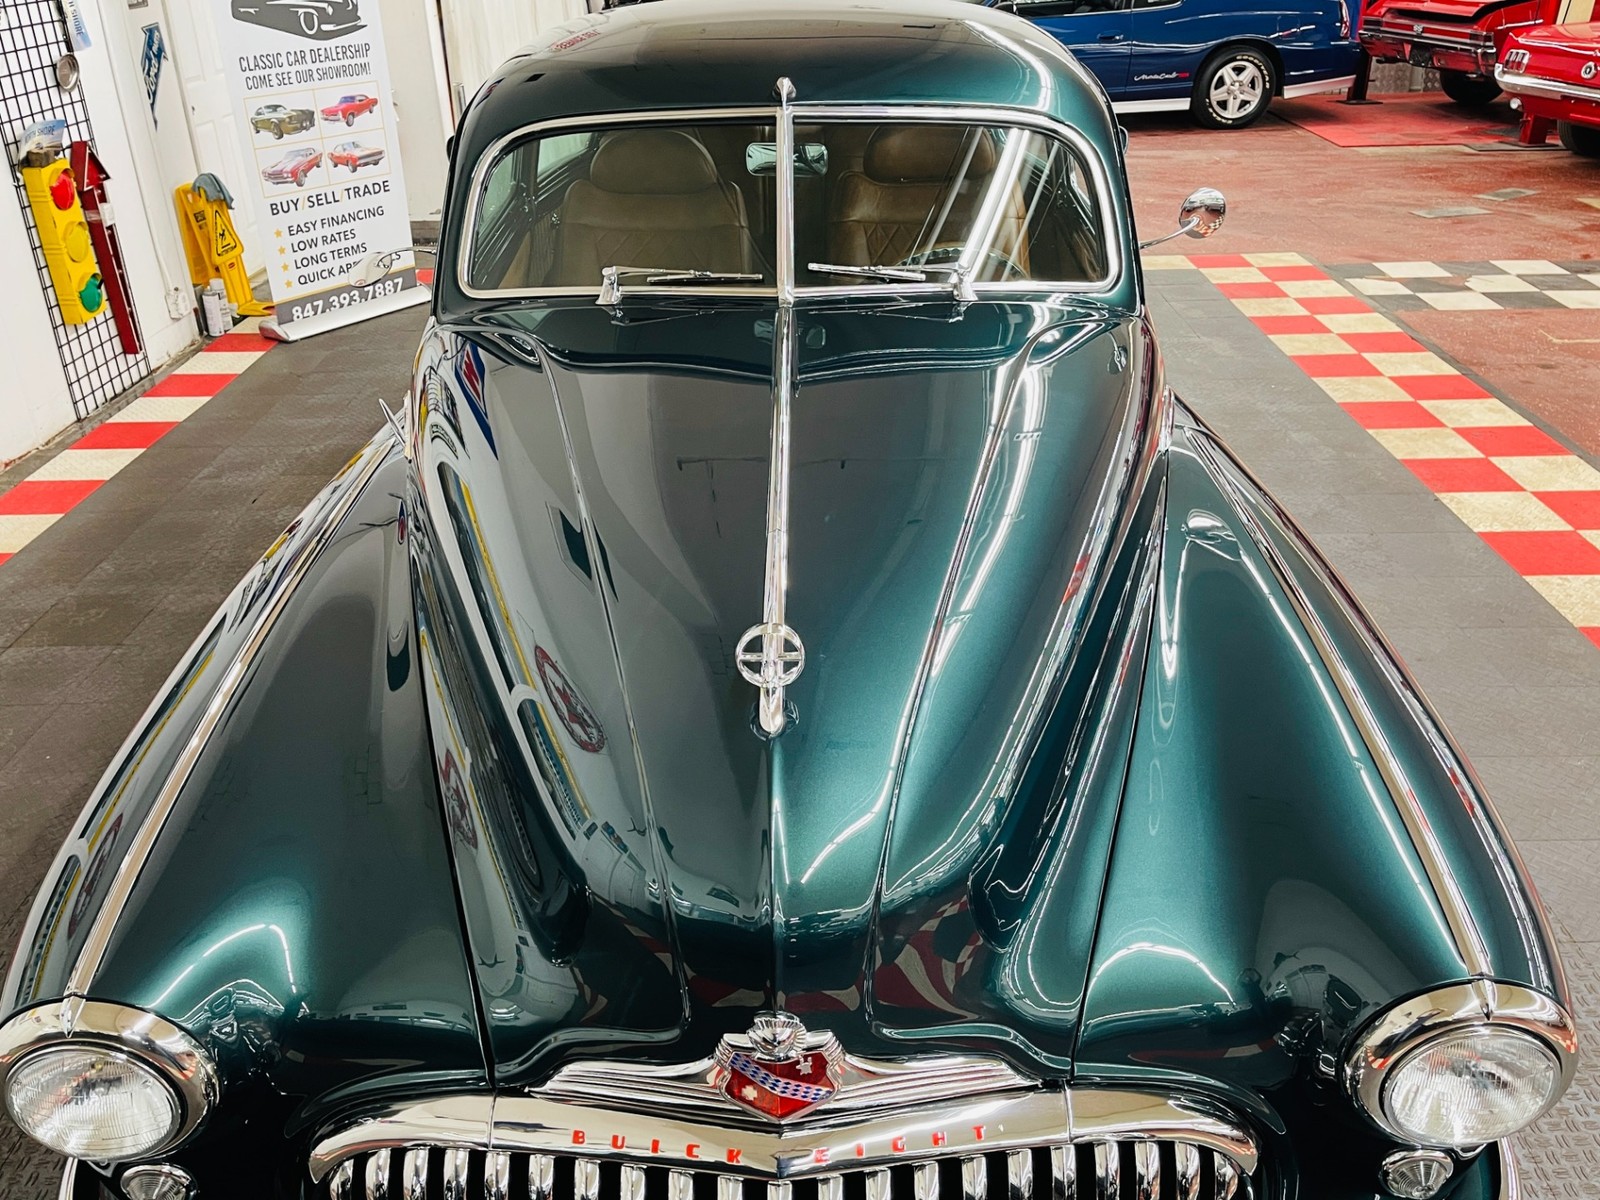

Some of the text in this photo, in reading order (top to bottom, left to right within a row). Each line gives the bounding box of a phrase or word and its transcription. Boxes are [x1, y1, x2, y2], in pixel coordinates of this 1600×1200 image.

[239, 43, 371, 72] CLASSIC CAR DEALERSHIP
[245, 62, 371, 90] COME SEE OUR SHOWROOM!
[287, 205, 385, 236] EASY FINANCING
[291, 228, 357, 253] LOW RATES
[294, 252, 328, 270] LONG
[330, 242, 367, 259] TERMS
[297, 267, 335, 286] QUICK
[291, 277, 404, 322] 847.393.7887
[572, 1125, 986, 1164] BUICK EIGHT
